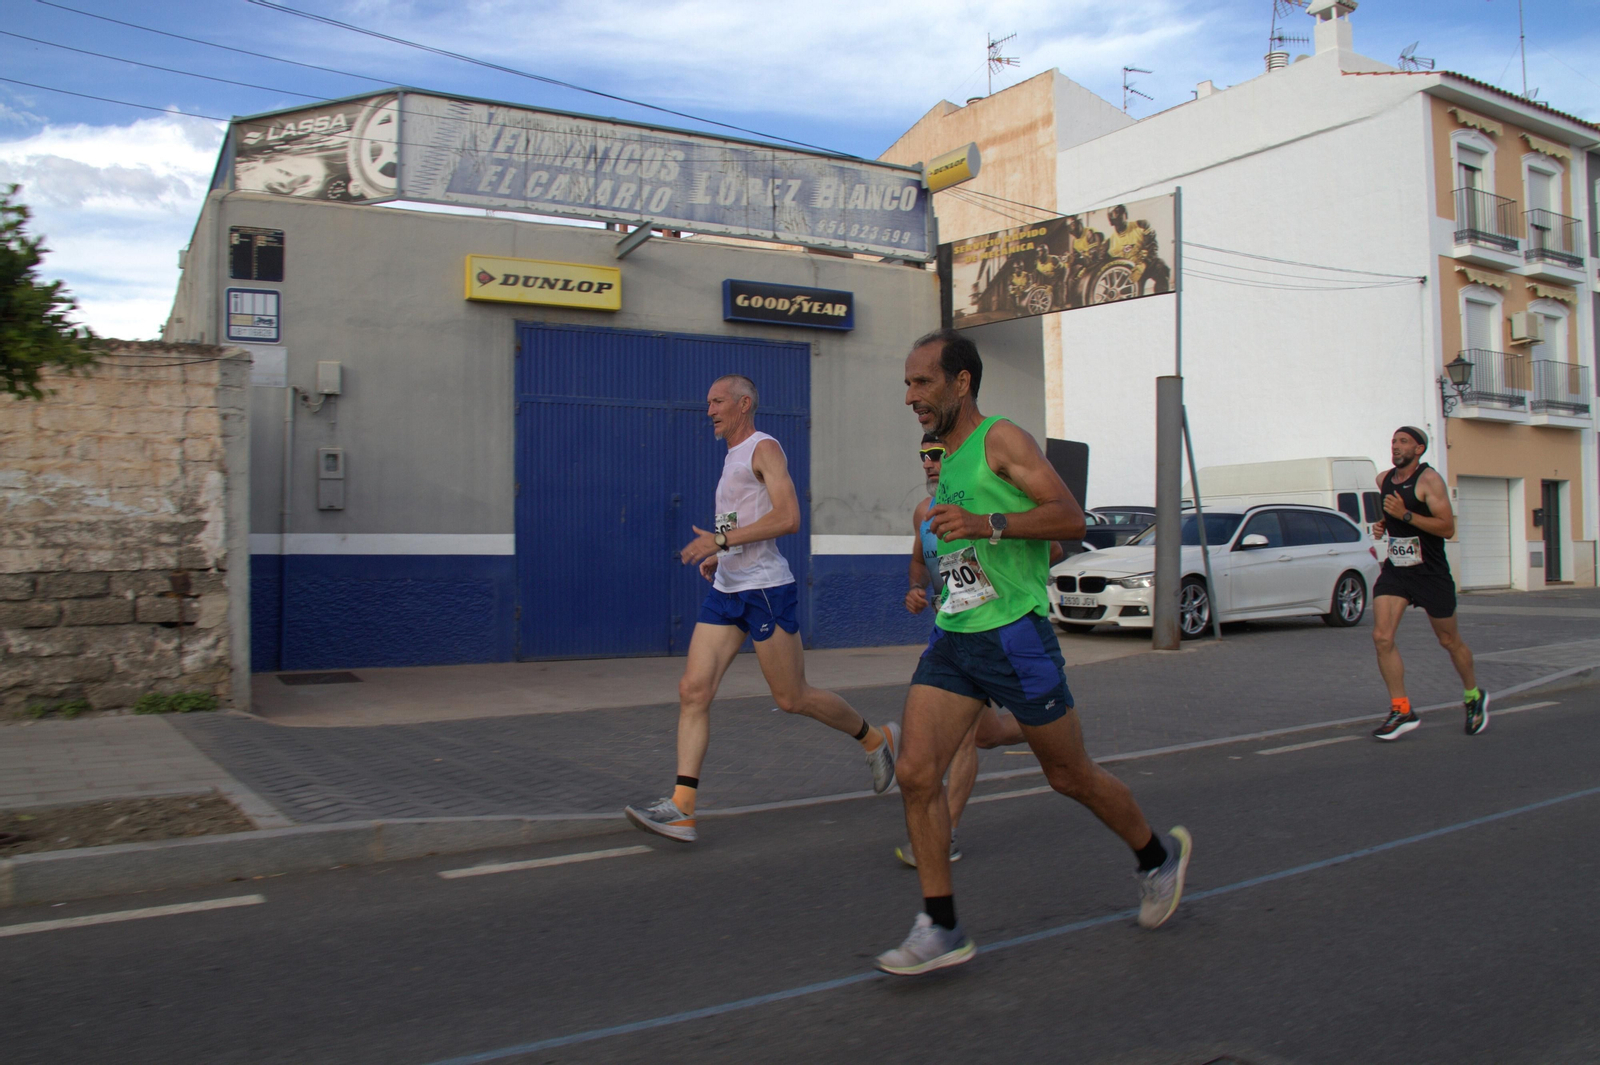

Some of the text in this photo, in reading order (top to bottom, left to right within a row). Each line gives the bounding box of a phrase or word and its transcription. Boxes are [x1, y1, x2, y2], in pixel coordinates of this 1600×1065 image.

[267, 113, 347, 141] LASSA
[933, 157, 966, 175] DUNLOP
[477, 165, 673, 213] EL CANARIO
[850, 224, 879, 240] 823
[964, 255, 977, 264] DE
[499, 274, 613, 294] DUNLOP
[1392, 545, 1415, 556] 664
[940, 565, 977, 588] 790
